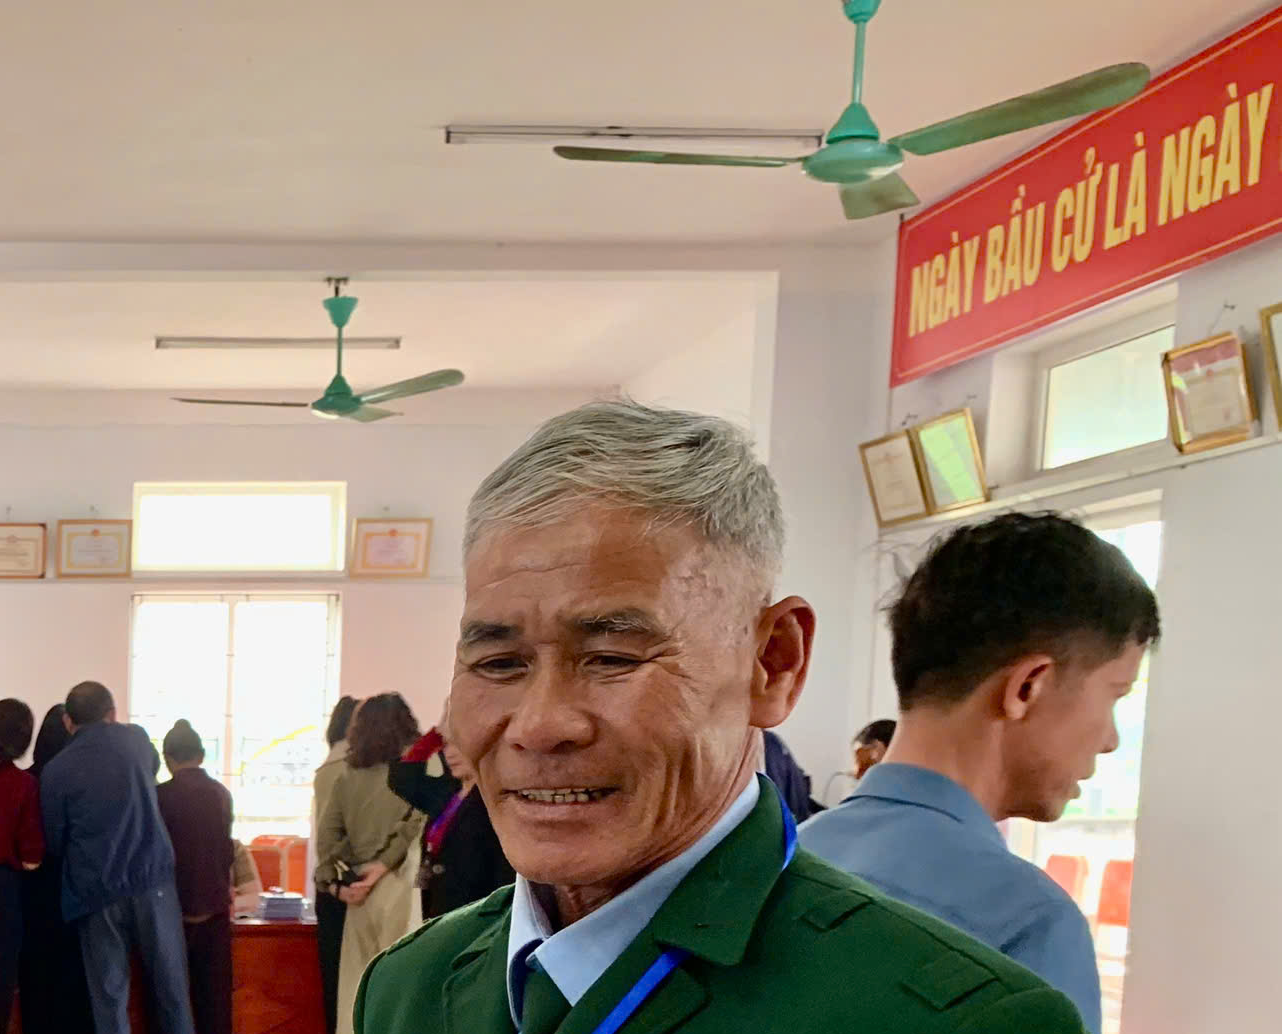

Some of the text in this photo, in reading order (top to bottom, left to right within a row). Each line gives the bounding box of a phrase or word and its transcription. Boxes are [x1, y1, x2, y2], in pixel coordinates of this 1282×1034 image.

[908, 82, 1274, 338] NGÀY BẦU CỬ LÀ NGÀY
